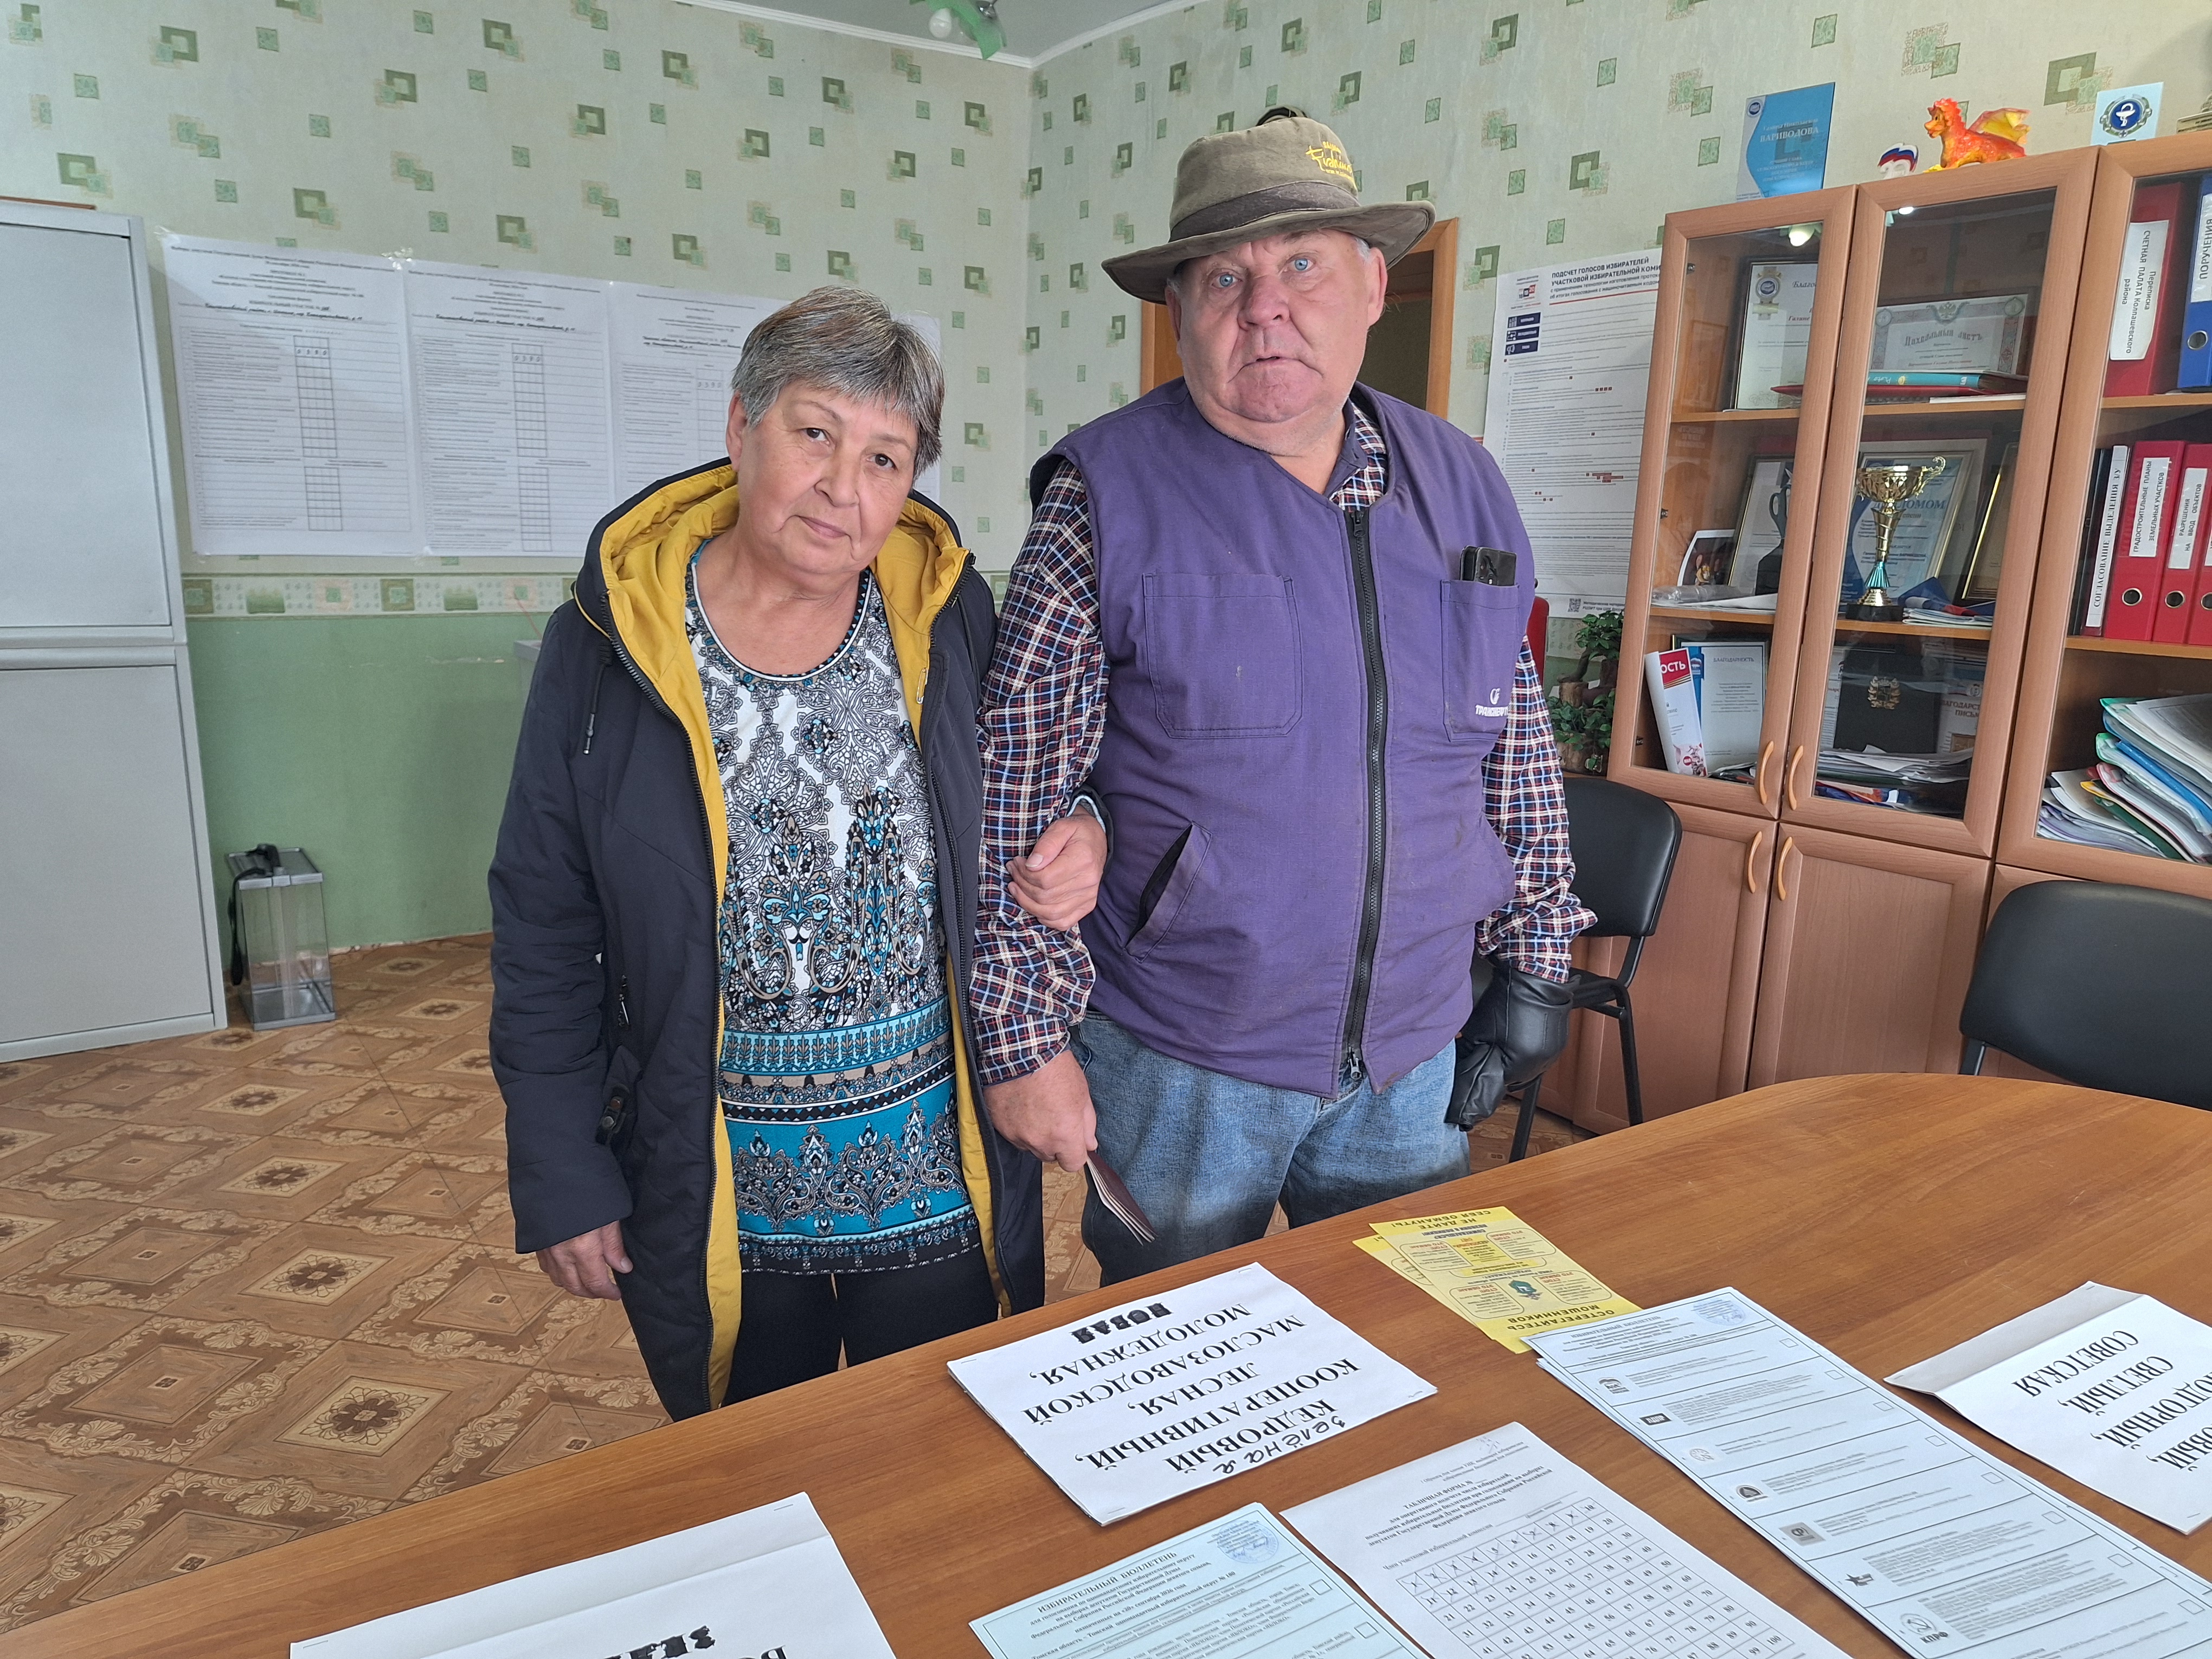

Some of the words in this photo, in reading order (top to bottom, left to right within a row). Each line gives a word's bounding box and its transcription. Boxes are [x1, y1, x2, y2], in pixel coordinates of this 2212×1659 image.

[1760, 126, 1819, 142] ВАРИВОДОВА
[2140, 230, 2150, 263] СЧЕТНАЯ
[2200, 218, 2212, 280] ПОРУЧЕНИЯ
[1551, 274, 1589, 286] УЧАСТКОВОЙ
[1590, 266, 1639, 280] ИЗБИРАТЕЛЬНОЙ
[1552, 269, 1577, 278] ПОДСЧЕТ
[1578, 265, 1604, 274] ГОЛОСОВ
[1606, 256, 1649, 269] ИЗБИРАТЕЛЕЙ
[2122, 279, 2131, 305] района
[2135, 267, 2145, 297] ПАЛАТА
[2144, 271, 2156, 310] Переписка
[2126, 298, 2141, 353] Колпашевского
[1874, 499, 1946, 510] ДЛОМОМ
[2133, 486, 2149, 552] ГРАДОСТРОИТЕЛЬНЫЕ
[2144, 461, 2152, 484] ПЛАНЫ
[2149, 504, 2160, 542] ЗЕМЕЛЬНЫХ
[2155, 472, 2164, 503] УЧАСТКОВ
[2191, 484, 2202, 513] ОБЪЕКТОВ
[2179, 498, 2190, 536] РАЗРЕШЕНИЯ
[2188, 520, 2196, 536] ВВОД
[2094, 540, 2110, 607] СОГЛАСОВАНИЕ
[2105, 484, 2119, 536] ВЫДЕЛЕНИЯ
[2184, 543, 2191, 551] НА
[1661, 661, 1687, 674] ОСТЬ
[1391, 1215, 1457, 1227] ОБМАНУТЬ!
[1418, 1220, 1457, 1229] ДАЙТЕ
[1070, 1302, 1172, 1343] НОВАЯ
[1507, 1304, 1600, 1323] МОШЕННИКОВ
[1507, 1307, 1614, 1330] ОСТЕРЕГАЙТЕСЬ
[1570, 1324, 1623, 1338] ИЗБИРАТЕЛЬНЫЙ
[1623, 1316, 1661, 1326] БЮЛЛЕТЕНЬ
[1029, 1303, 1251, 1385] МОЛОДЕЖНАЯ,
[1022, 1315, 1305, 1425] МАСЛОЗАВОДСКОЙ
[2011, 1330, 2138, 1397] СОВЕТСКАЯ
[1127, 1362, 1258, 1415] ЛЕСНАЯ,
[2057, 1356, 2172, 1416] СВЕТЛЫЙ,
[1075, 1359, 1359, 1470] КООПЕРАТИВНЫЙ,
[1645, 1415, 1666, 1423] ЛДПР
[1163, 1399, 1336, 1473] КЕДРОВЫЙ
[1403, 1491, 1443, 1509] ТАБЛИЧНАЯ
[1442, 1483, 1466, 1493] ФОРМА
[1443, 1507, 1461, 1516] Думы
[1038, 1576, 1118, 1612] ИЗБИРАТЕЛЬНЫЙ
[1120, 1552, 1176, 1578] БЮЛЛЕТЕНЬ
[1041, 1604, 1078, 1620] голосования
[1086, 1580, 1132, 1602] одномандатному
[1132, 1562, 1176, 1582] избирательному
[1176, 1554, 1195, 1563] округу
[1117, 1573, 1165, 1596] Государственной
[1164, 1566, 1181, 1576] Думы
[1681, 1574, 1692, 1583] 60
[1031, 1619, 1072, 1638] Федерального
[1073, 1607, 1102, 1621] Собрания
[1102, 1592, 1135, 1609] Российской
[1135, 1580, 1166, 1594] Федерации
[1135, 1594, 1161, 1607] сентября
[1160, 1588, 1174, 1596] 2026
[1722, 1605, 1734, 1613] 80
[1059, 1638, 1082, 1649] область
[1086, 1624, 1114, 1637] Томский
[1115, 1604, 1160, 1625] одномандатный
[1160, 1585, 1203, 1606] избирательный
[1203, 1579, 1218, 1587] округ
[1766, 1635, 1782, 1645] 100
[1920, 1631, 1949, 1643] КПРФ
